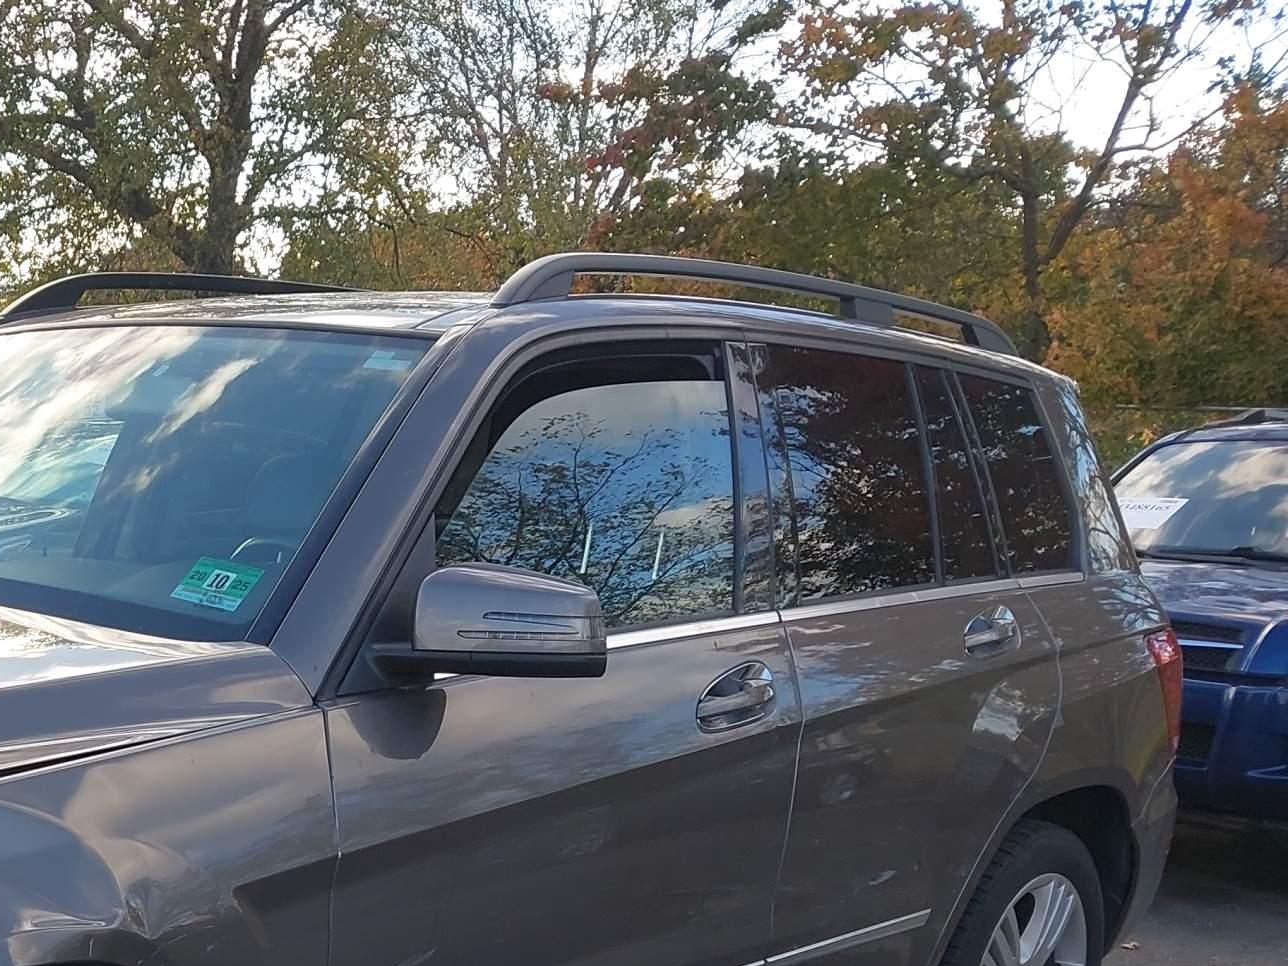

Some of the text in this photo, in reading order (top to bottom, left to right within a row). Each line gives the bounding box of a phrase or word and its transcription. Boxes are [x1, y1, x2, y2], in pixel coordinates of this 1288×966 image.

[190, 570, 251, 591] 20 10 25
